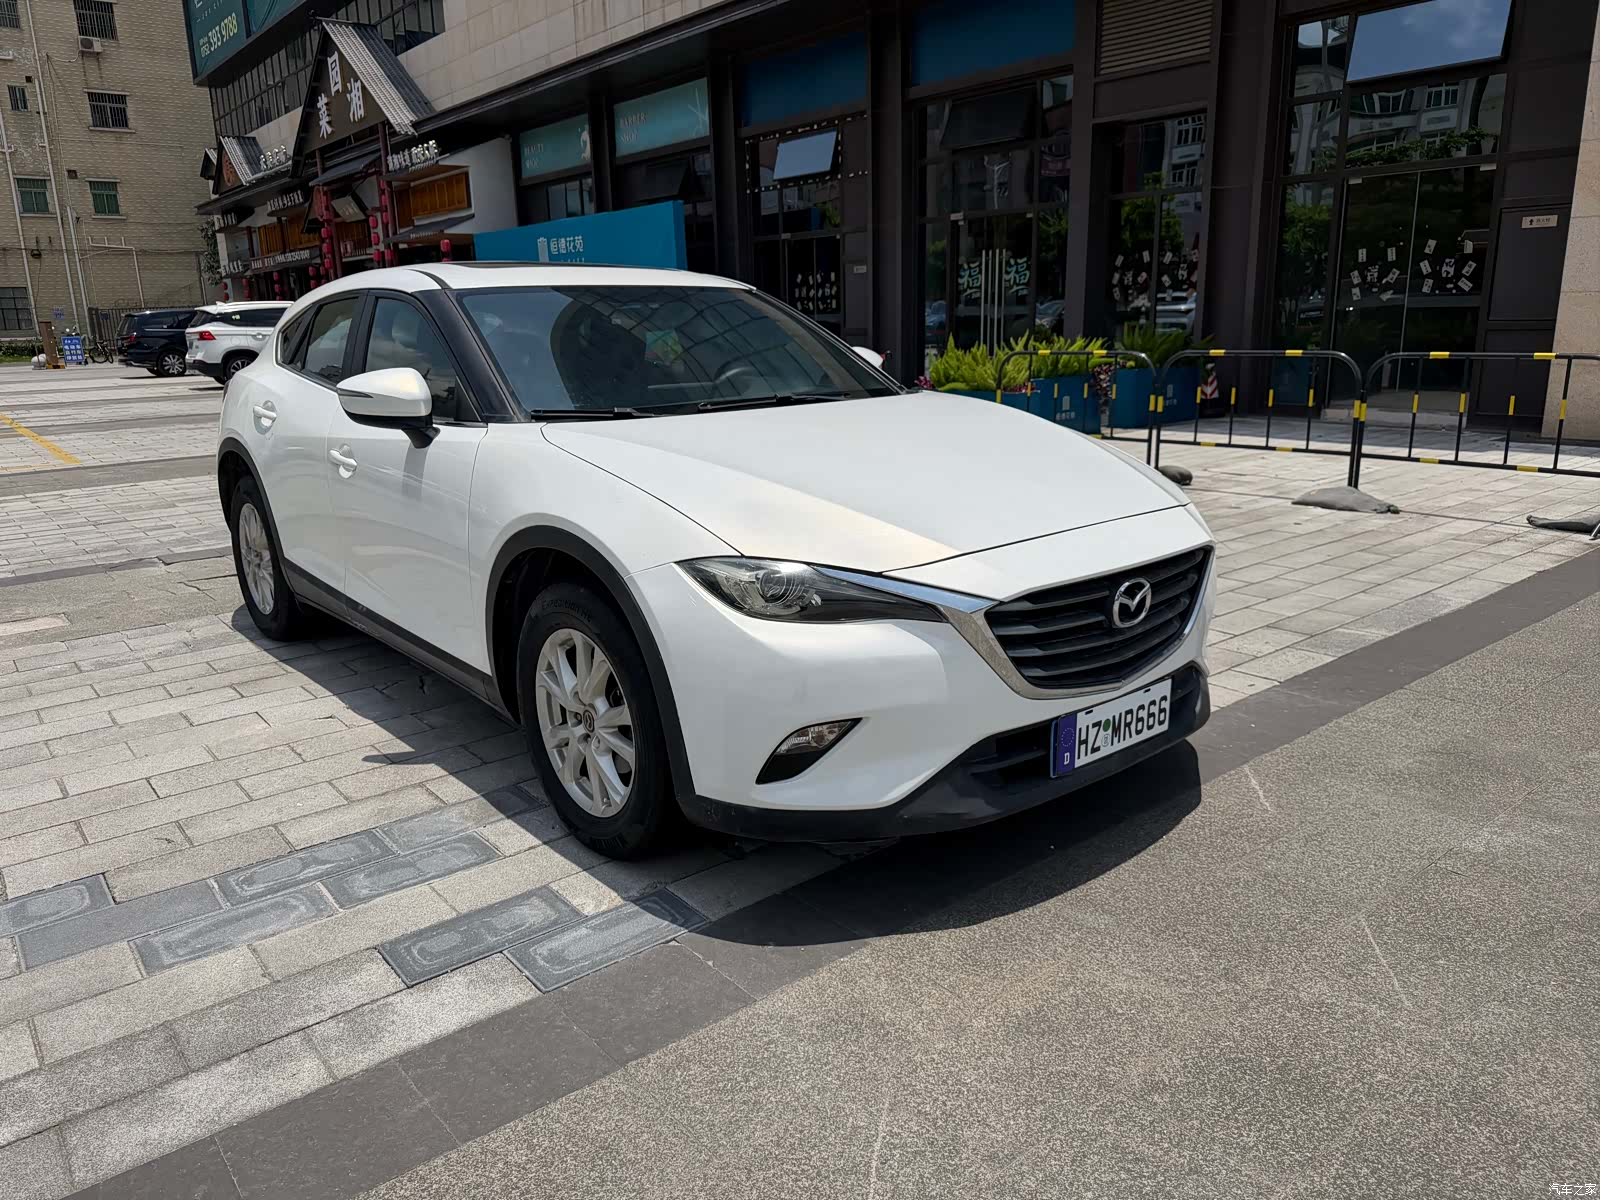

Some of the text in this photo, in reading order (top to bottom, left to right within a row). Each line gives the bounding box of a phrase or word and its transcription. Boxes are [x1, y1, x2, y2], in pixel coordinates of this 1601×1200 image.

[208, 25, 222, 52] 393
[221, 12, 238, 43] 9788
[327, 51, 343, 97] 园
[316, 92, 334, 140] 菜
[346, 78, 365, 123] 湘
[958, 261, 982, 289] 福
[1004, 257, 1031, 286] 福
[1077, 695, 1168, 760] HZ MR666
[1063, 752, 1070, 765] D
